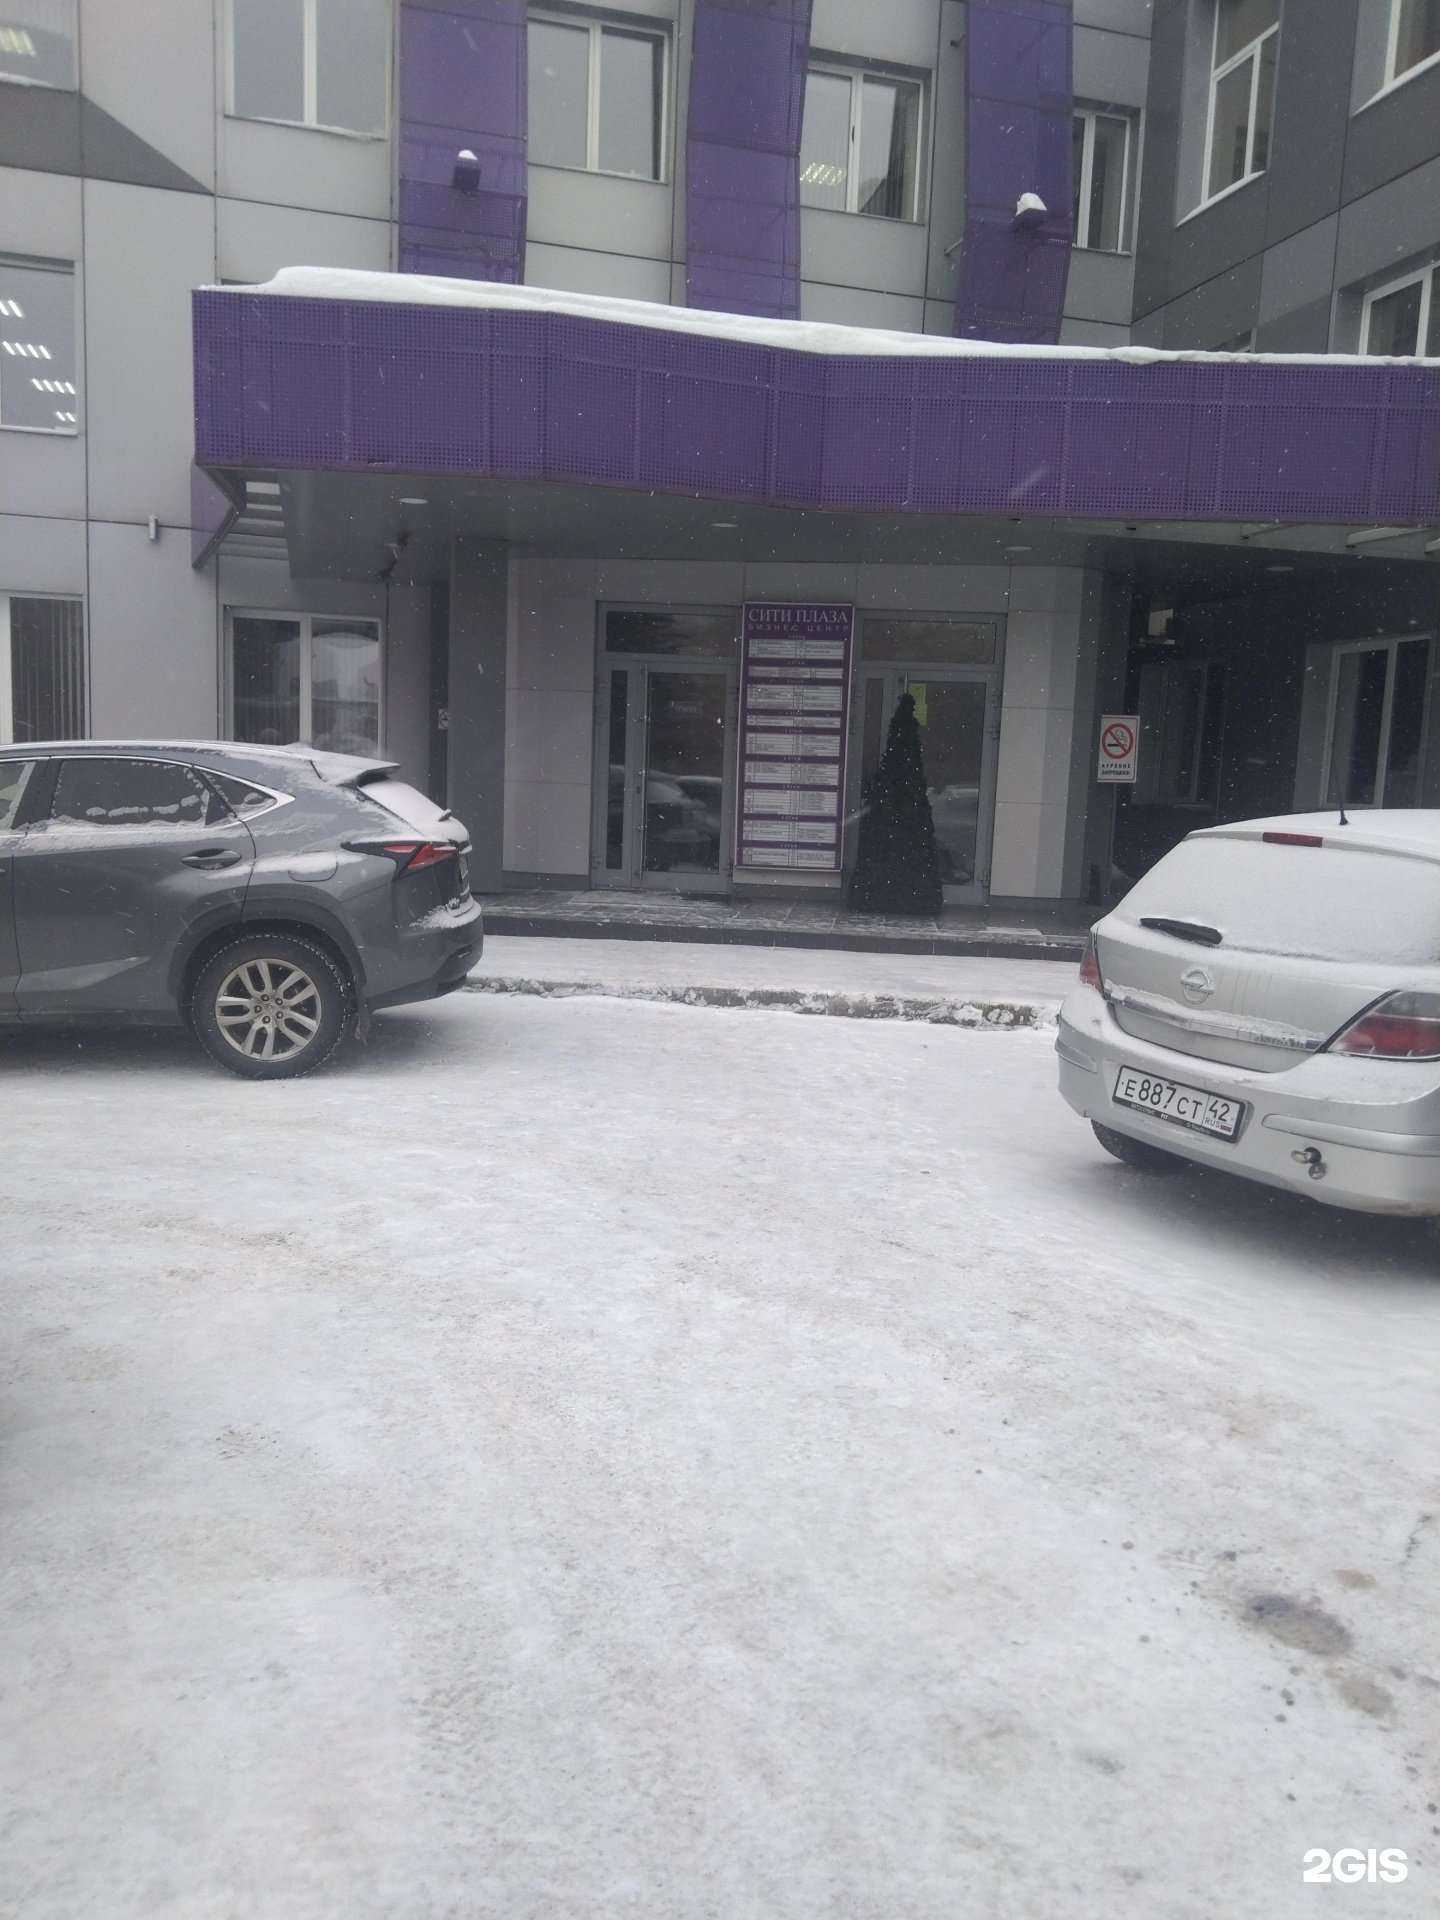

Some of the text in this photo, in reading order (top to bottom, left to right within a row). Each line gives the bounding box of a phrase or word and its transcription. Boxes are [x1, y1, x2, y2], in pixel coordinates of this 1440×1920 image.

[748, 608, 848, 624] СИТИ ПЛАЗА
[1208, 1099, 1231, 1122] 42
